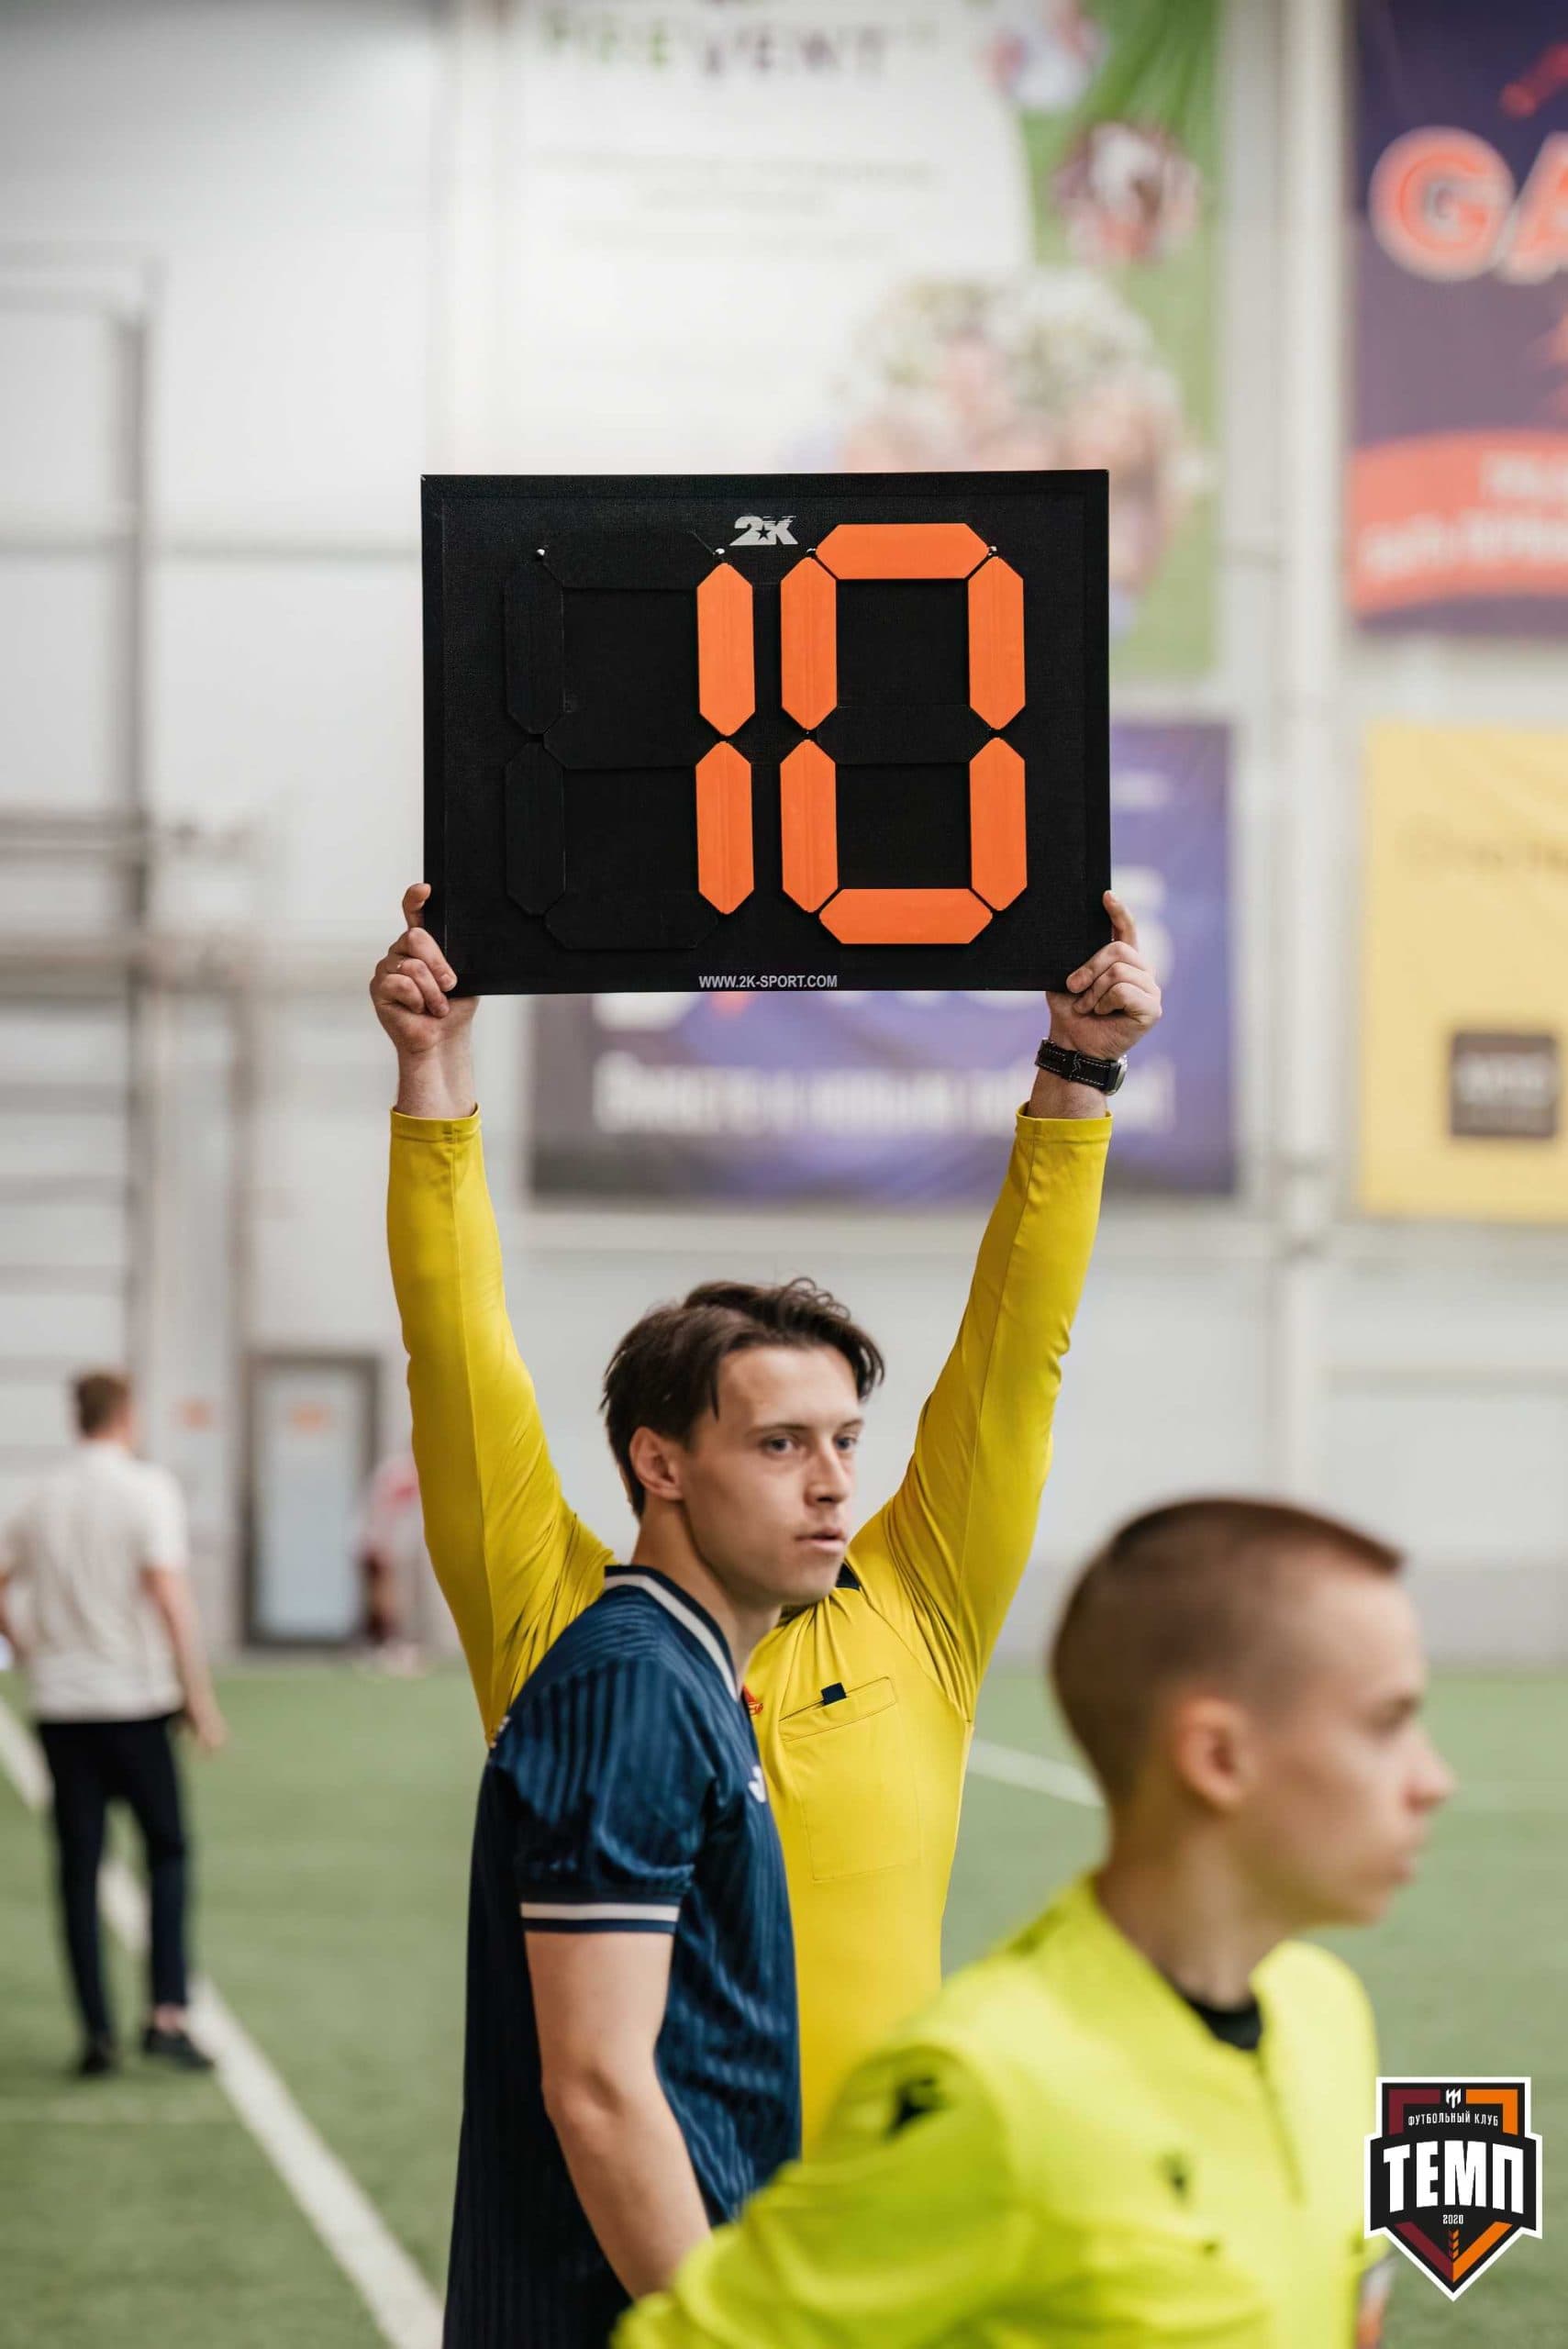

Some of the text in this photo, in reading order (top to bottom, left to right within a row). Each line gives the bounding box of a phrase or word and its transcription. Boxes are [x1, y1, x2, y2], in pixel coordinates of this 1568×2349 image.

[729, 515, 798, 546] 2K
[695, 522, 1027, 945] 10
[698, 974, 838, 988] WWW.2K-SPORT.COM
